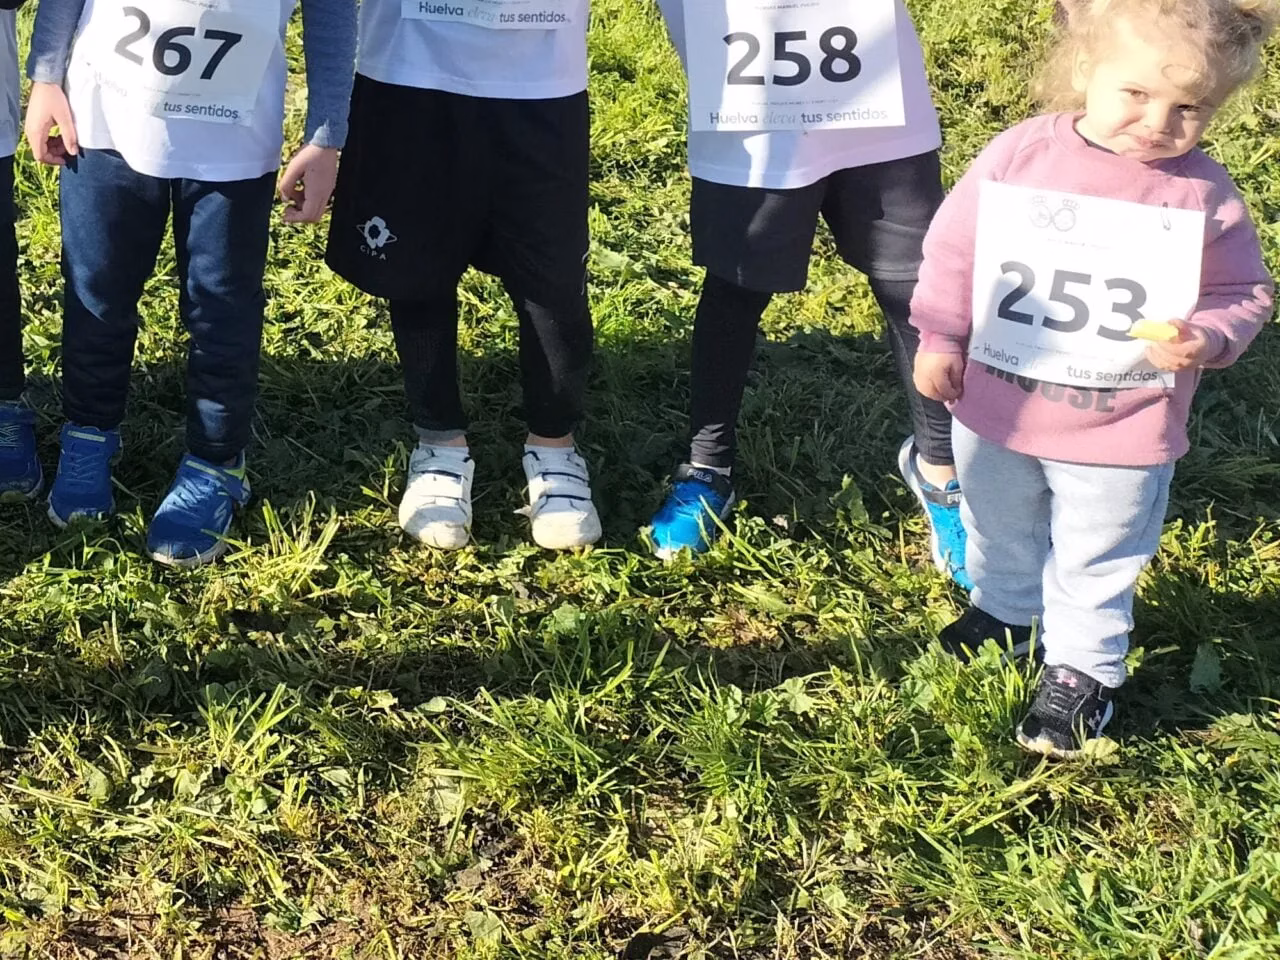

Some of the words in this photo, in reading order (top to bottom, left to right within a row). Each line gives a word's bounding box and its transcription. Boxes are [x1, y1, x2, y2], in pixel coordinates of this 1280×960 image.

[419, 1, 464, 16] Huelva
[499, 12, 515, 23] tus
[518, 11, 566, 23] sentidos
[114, 5, 243, 80] 267
[722, 26, 861, 86] 258
[164, 102, 182, 113] tus
[184, 104, 238, 119] sentidos
[709, 112, 758, 124] Huelva
[801, 112, 823, 124] tus
[826, 108, 888, 122] sentidos
[997, 260, 1147, 342] 253
[983, 342, 1019, 366] Huelva
[1066, 365, 1092, 379] tus
[1096, 370, 1158, 382] sentidos
